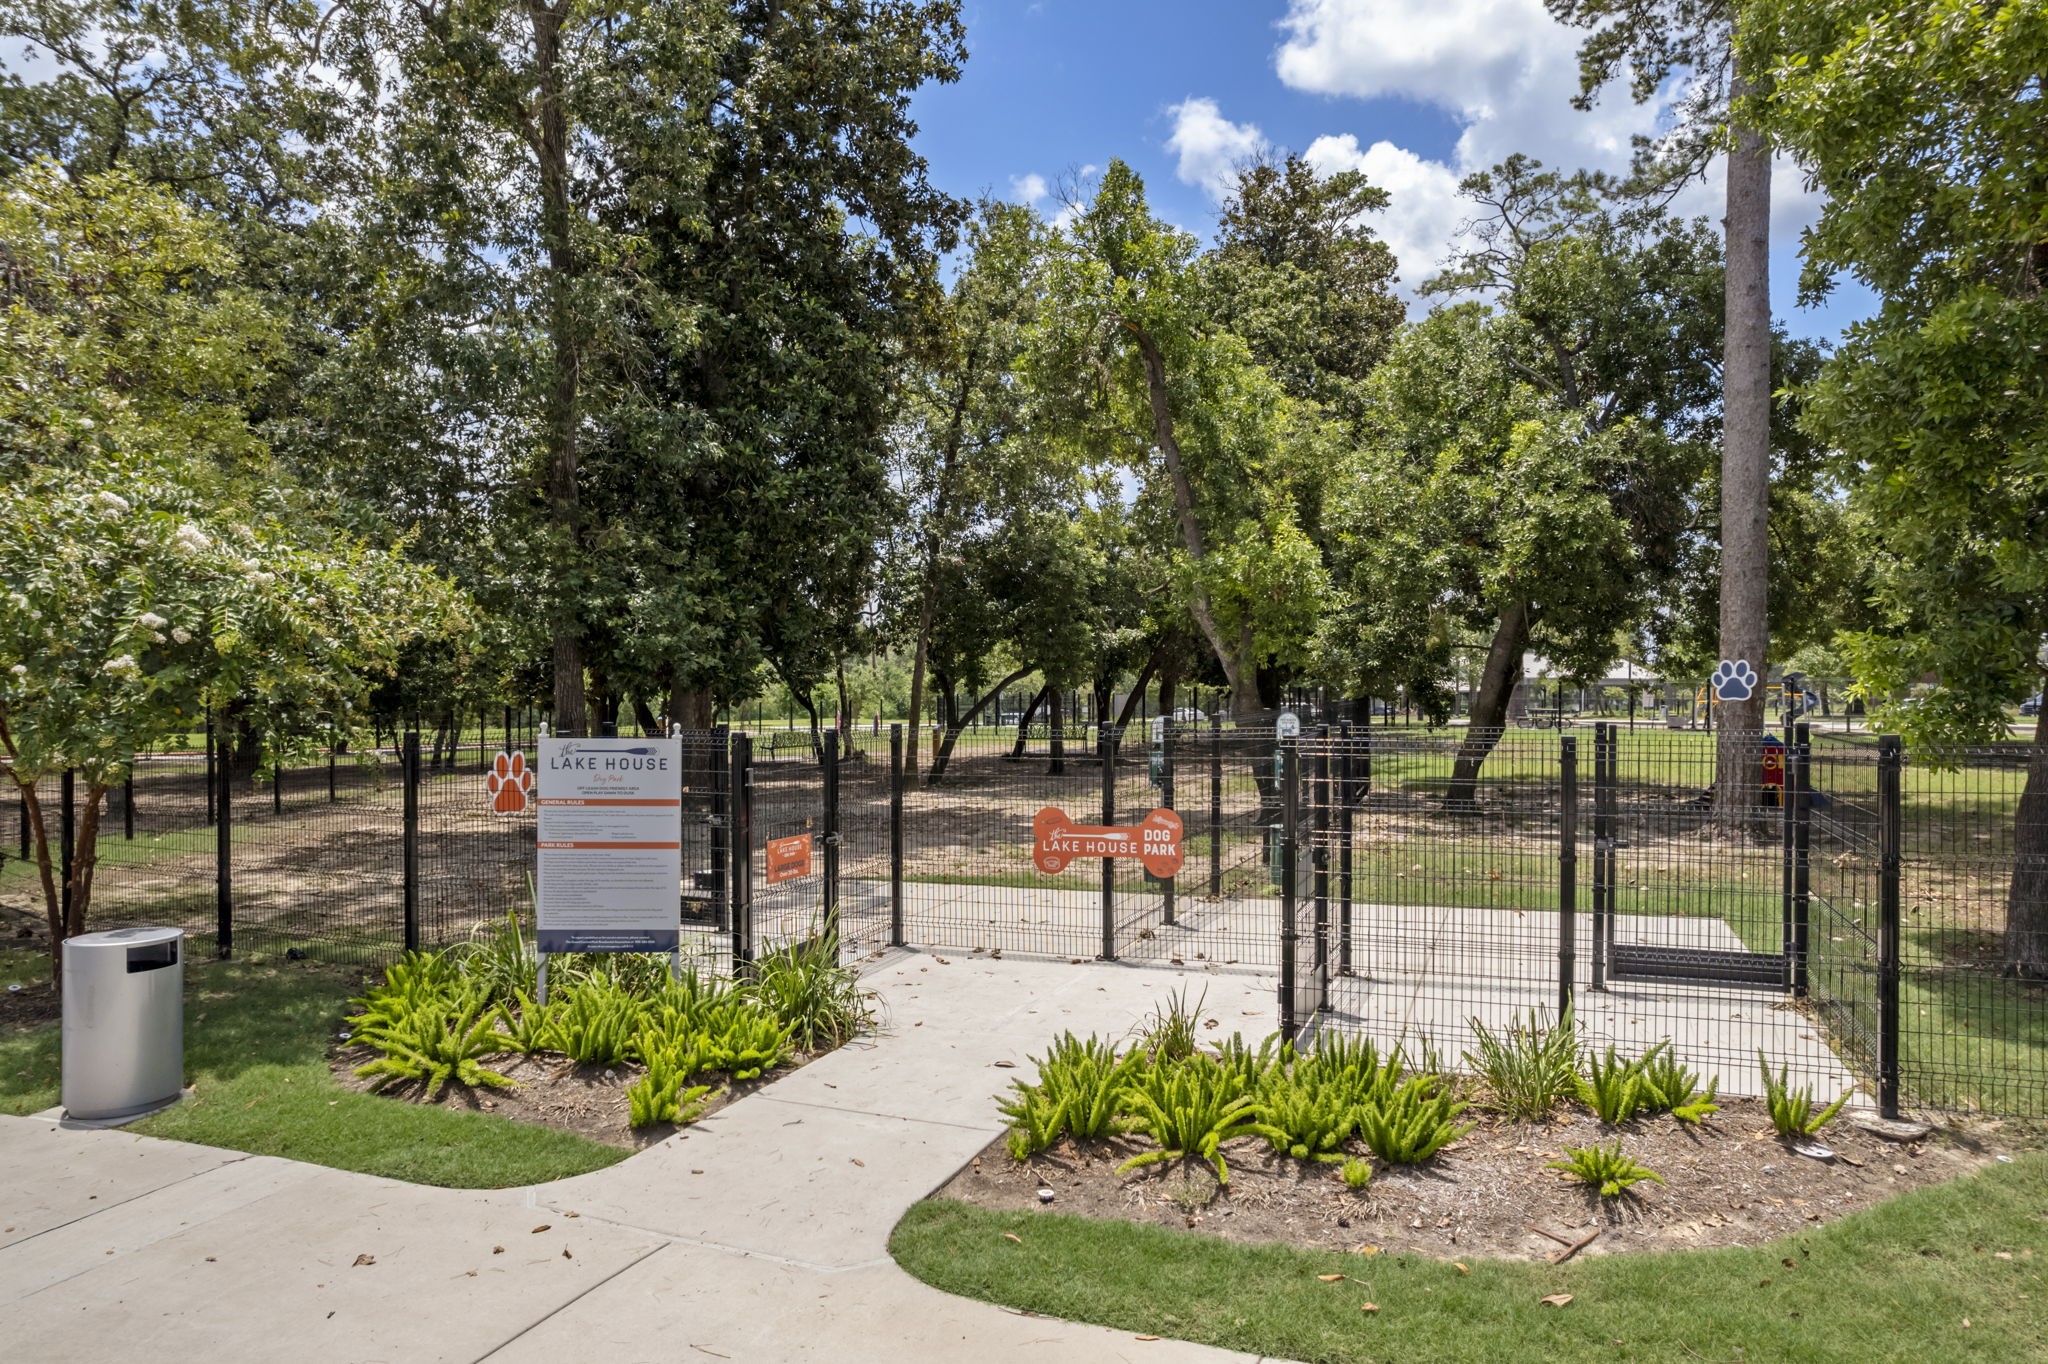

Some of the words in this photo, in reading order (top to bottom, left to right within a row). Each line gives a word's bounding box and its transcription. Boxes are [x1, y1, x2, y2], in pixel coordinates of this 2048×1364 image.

[551, 758, 597, 770] LAKE
[606, 758, 668, 771] HOUSE
[1144, 829, 1171, 842] DOG
[1042, 840, 1079, 852] LAKE
[1086, 841, 1138, 854] HOUSE
[1144, 843, 1176, 856] PARK
